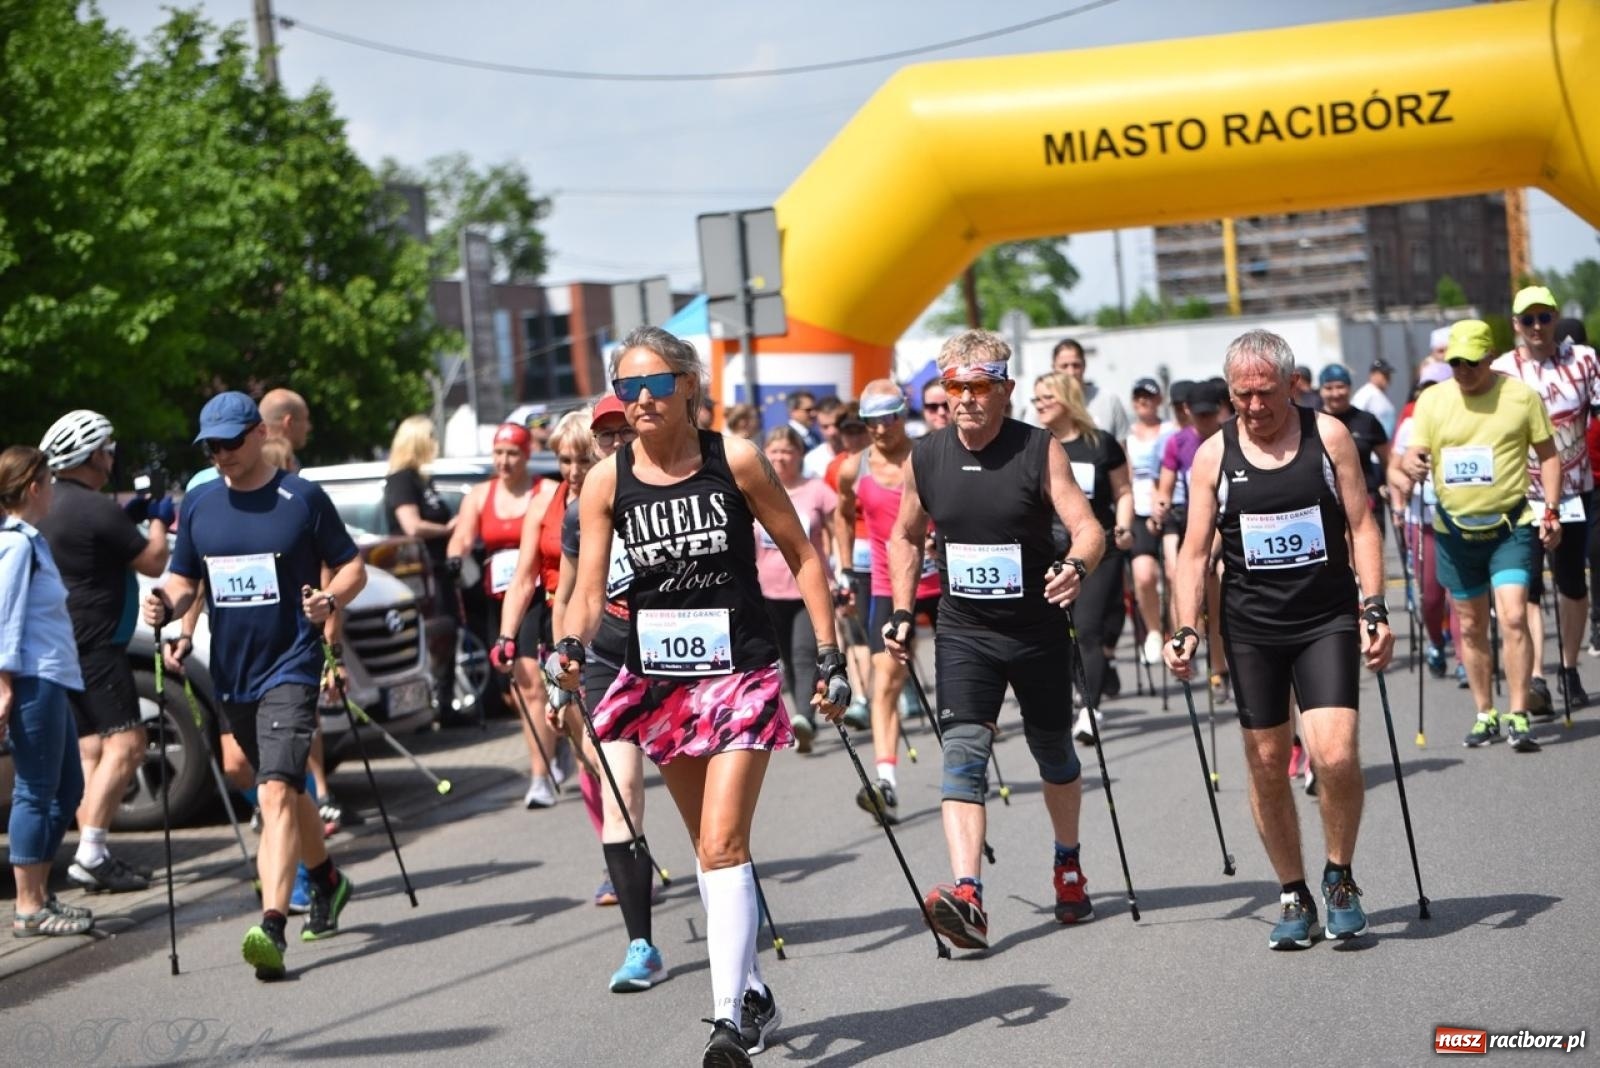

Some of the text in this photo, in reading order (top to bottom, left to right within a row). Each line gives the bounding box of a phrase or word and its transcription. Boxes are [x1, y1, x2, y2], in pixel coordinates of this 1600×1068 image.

[1043, 88, 1453, 166] MIASTO RACIBÓRZ
[1454, 462, 1479, 475] 129
[624, 492, 729, 544] ANGELS
[628, 529, 729, 568] NEVER
[1264, 533, 1303, 555] 139
[228, 576, 257, 592] 114
[658, 560, 733, 593] alone
[966, 567, 1001, 584] 133
[693, 610, 722, 618] GRANIC
[661, 636, 707, 658] 108
